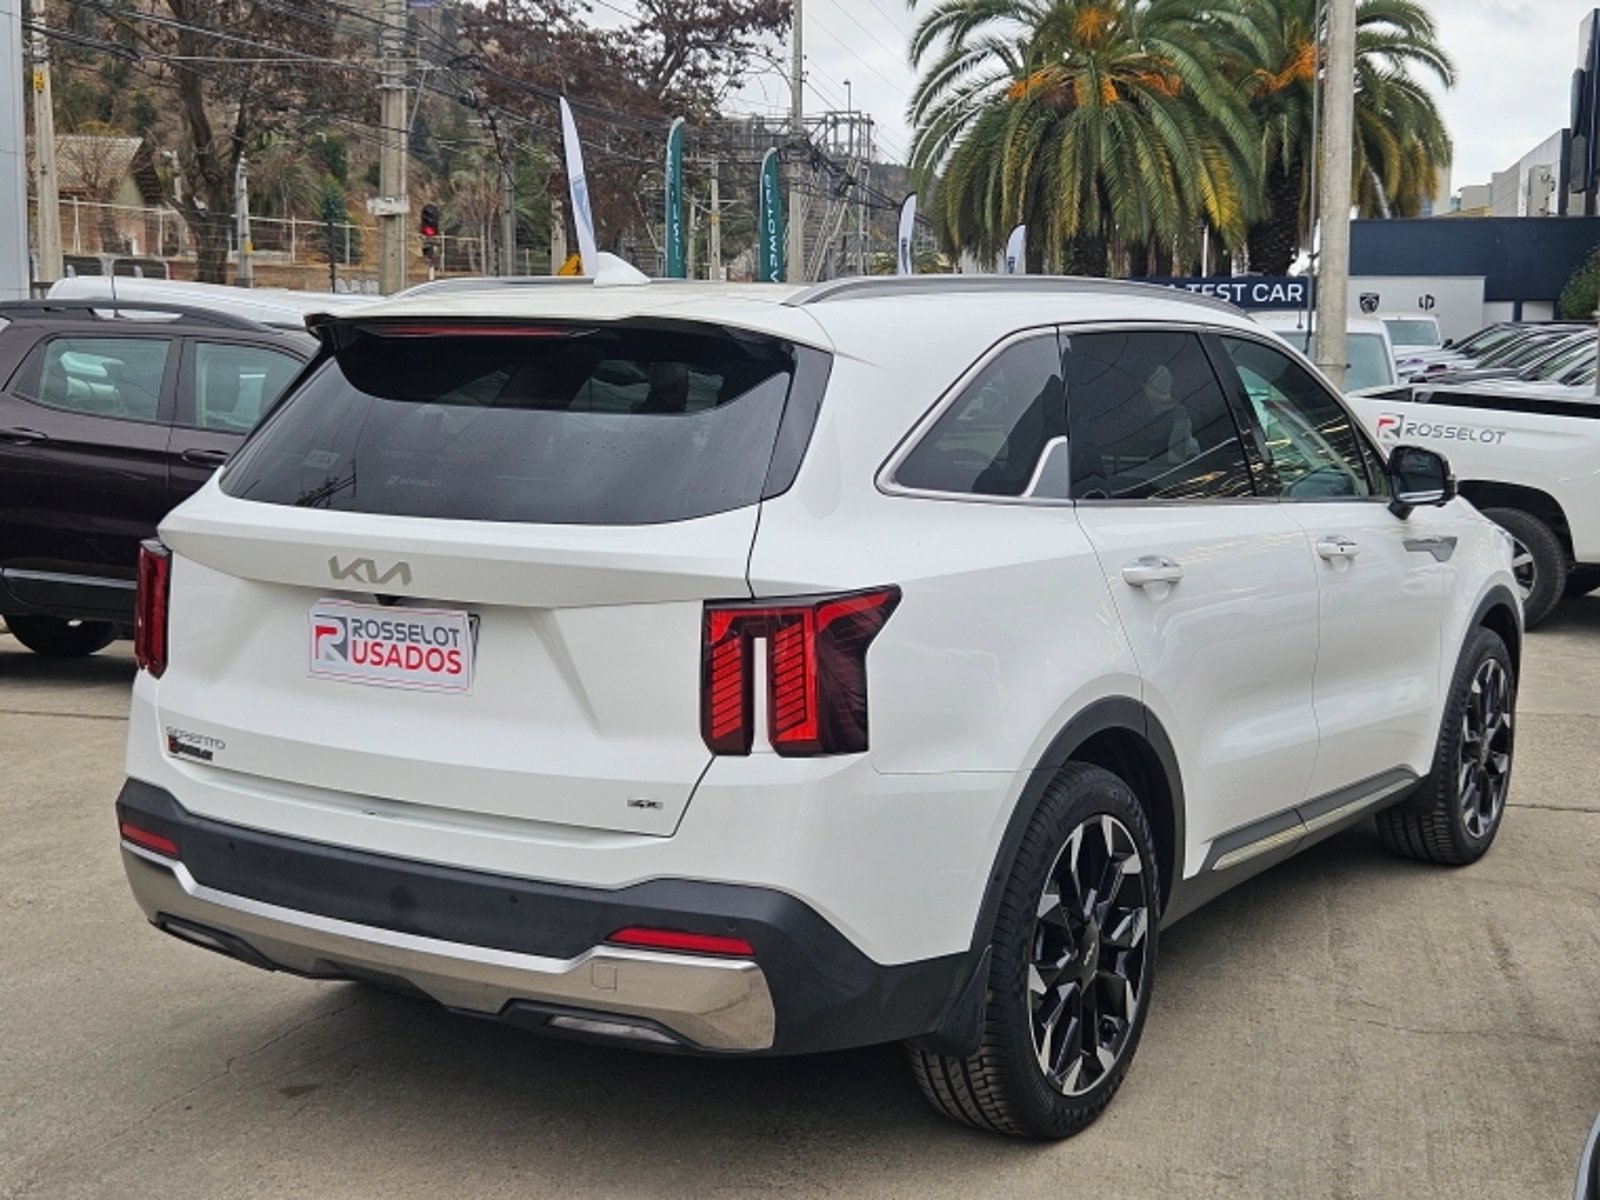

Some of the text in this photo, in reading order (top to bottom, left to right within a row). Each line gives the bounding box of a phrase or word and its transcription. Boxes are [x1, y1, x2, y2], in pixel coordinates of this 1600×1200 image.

[1186, 283, 1304, 303] TEST CAR
[1405, 422, 1507, 445] ROSSELOT
[328, 555, 413, 587] KIA
[351, 618, 460, 648] ROSSELOT
[352, 639, 462, 675] USADOS
